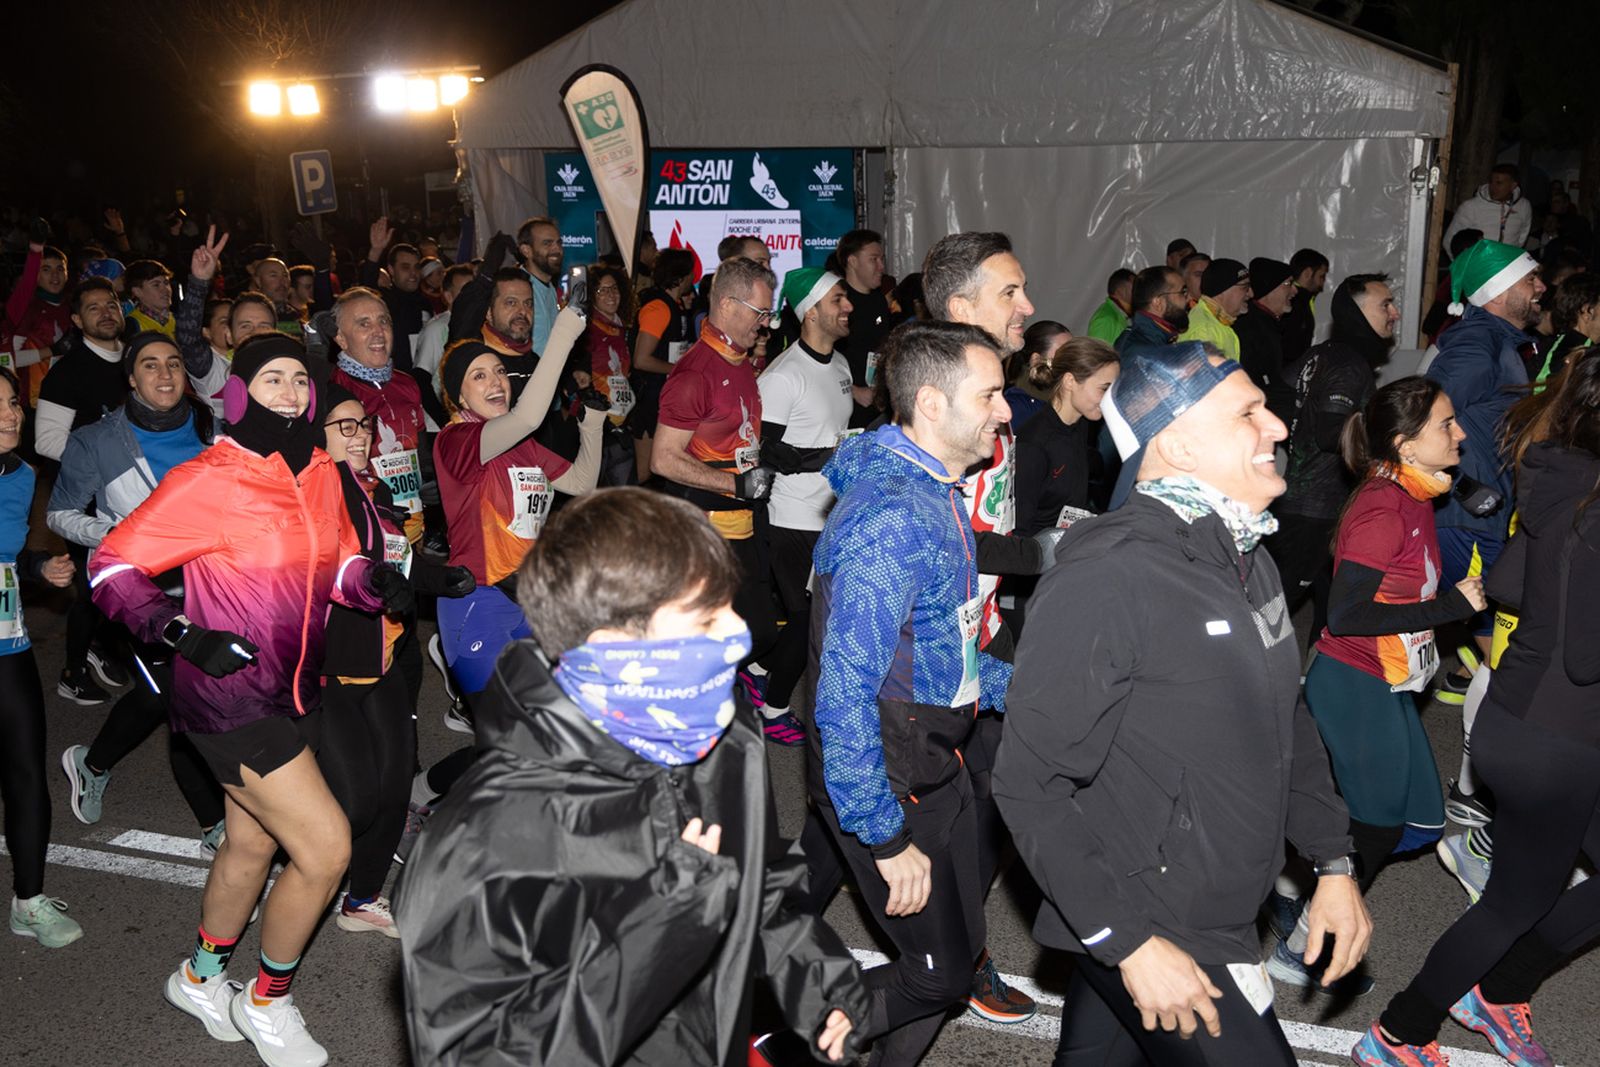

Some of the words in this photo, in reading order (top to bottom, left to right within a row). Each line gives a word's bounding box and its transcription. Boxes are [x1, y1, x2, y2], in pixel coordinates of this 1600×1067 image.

[660, 159, 687, 183] 43
[687, 159, 733, 181] SAN
[300, 159, 325, 207] P
[654, 177, 730, 205] ANTÓN
[761, 184, 776, 200] 43
[384, 468, 395, 477] SAN
[520, 483, 532, 492] SAN
[1411, 638, 1420, 647] SAN
[613, 683, 699, 700] SANTIAGO
